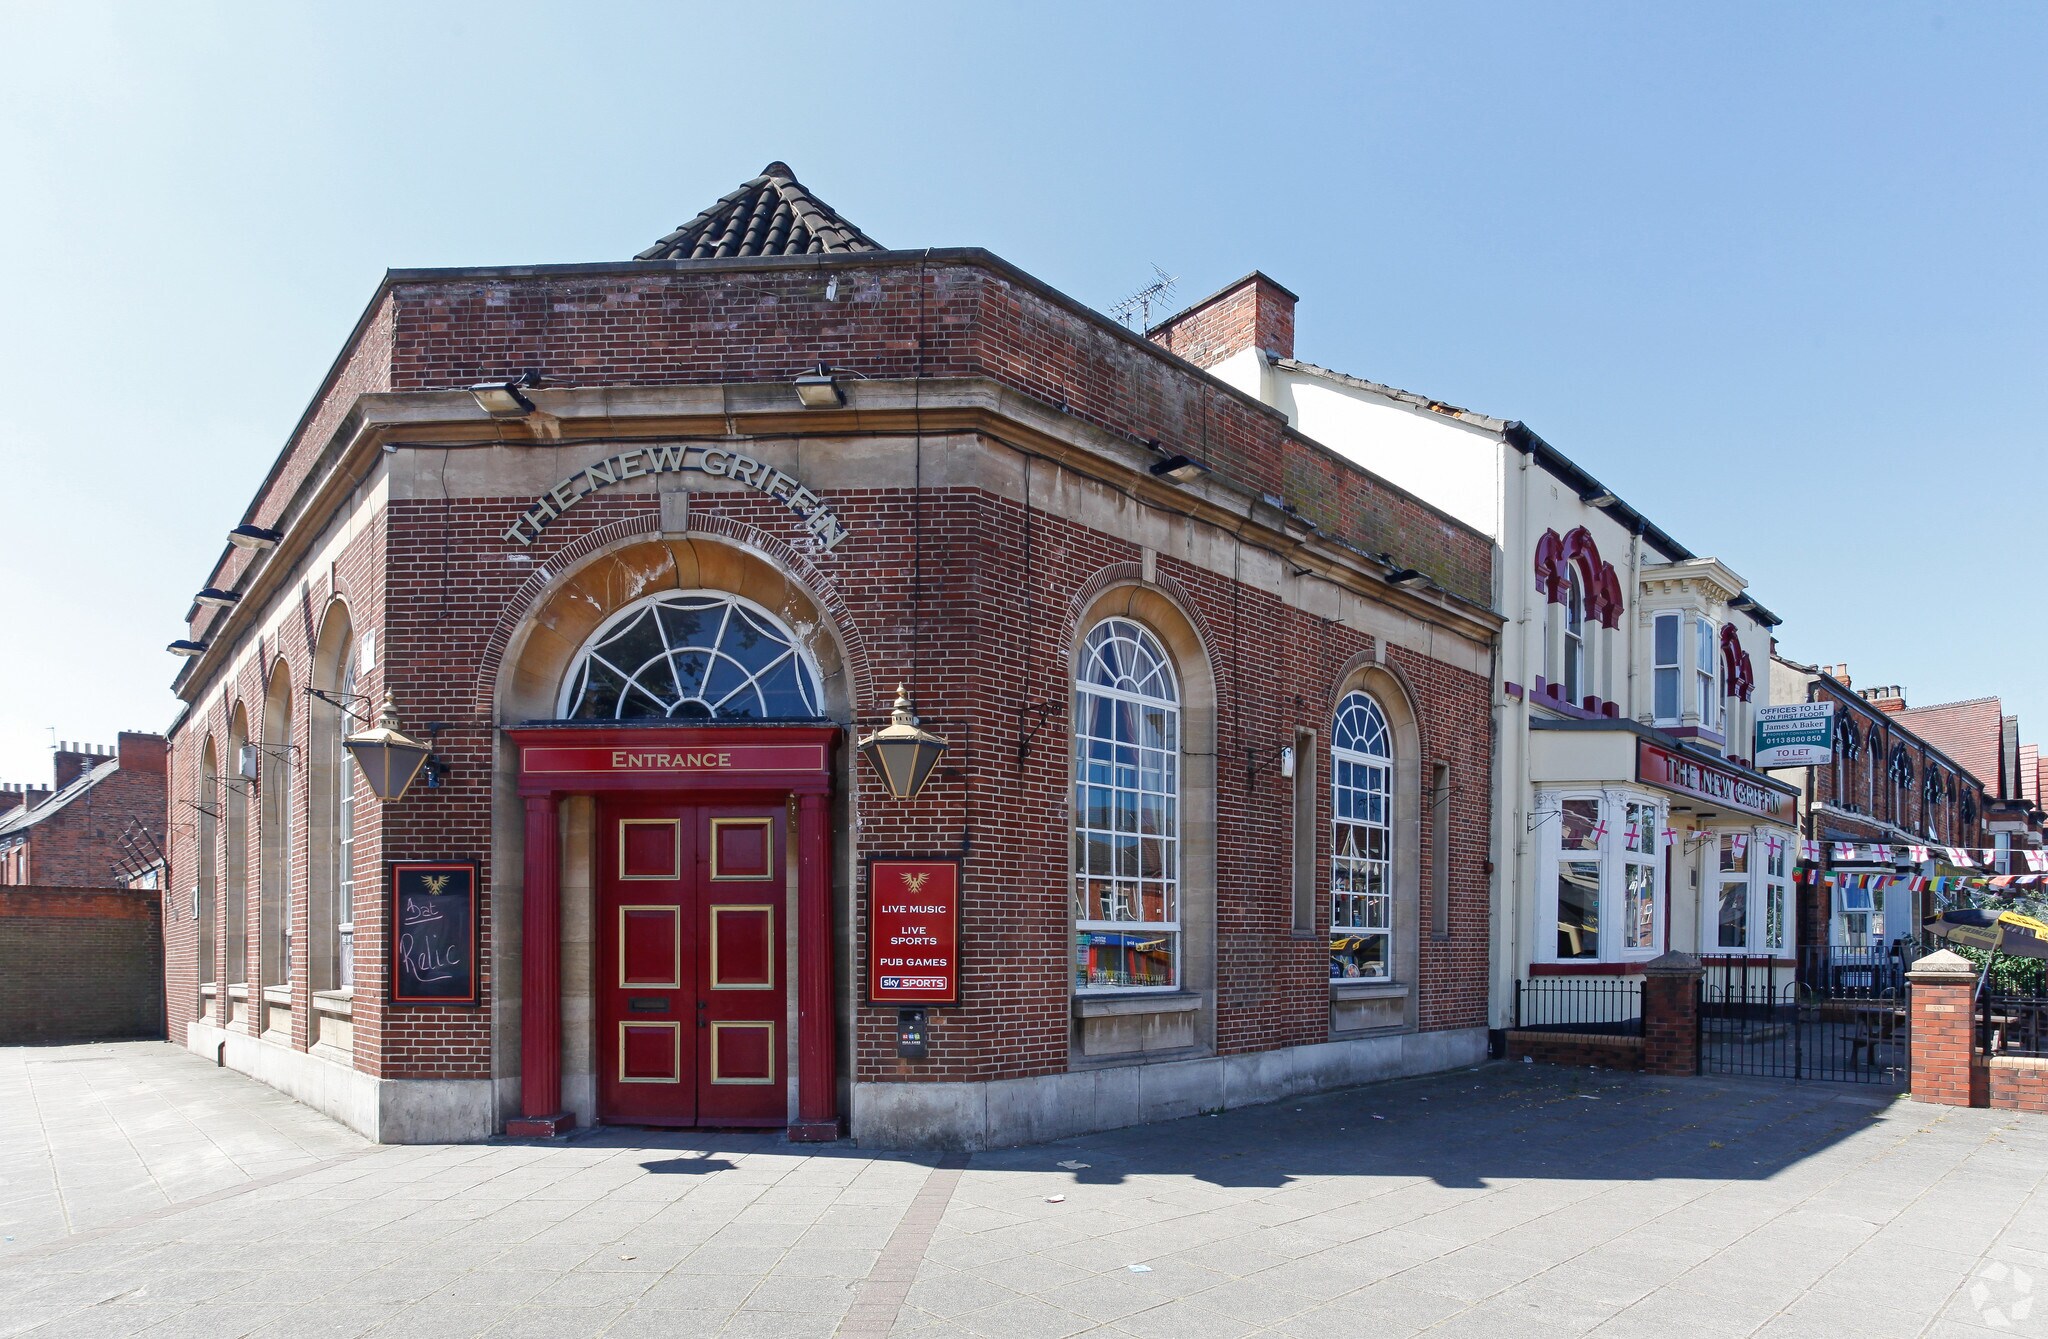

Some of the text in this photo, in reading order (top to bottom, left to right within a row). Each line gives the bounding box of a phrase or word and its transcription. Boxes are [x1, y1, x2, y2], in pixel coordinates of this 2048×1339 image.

[502, 445, 850, 551] THE NEW GRIFFIN
[1800, 720, 1823, 728] Baker
[1792, 748, 1810, 756] LET
[1667, 756, 1781, 814] THE NEW GRIFFIN
[881, 905, 947, 914] LIVE MUSIC
[901, 926, 927, 935] LIVE
[890, 937, 937, 945] SPORTS
[400, 933, 460, 982] Relic
[880, 958, 947, 967] PUB GAMES
[883, 977, 944, 988] sky SPORTS
